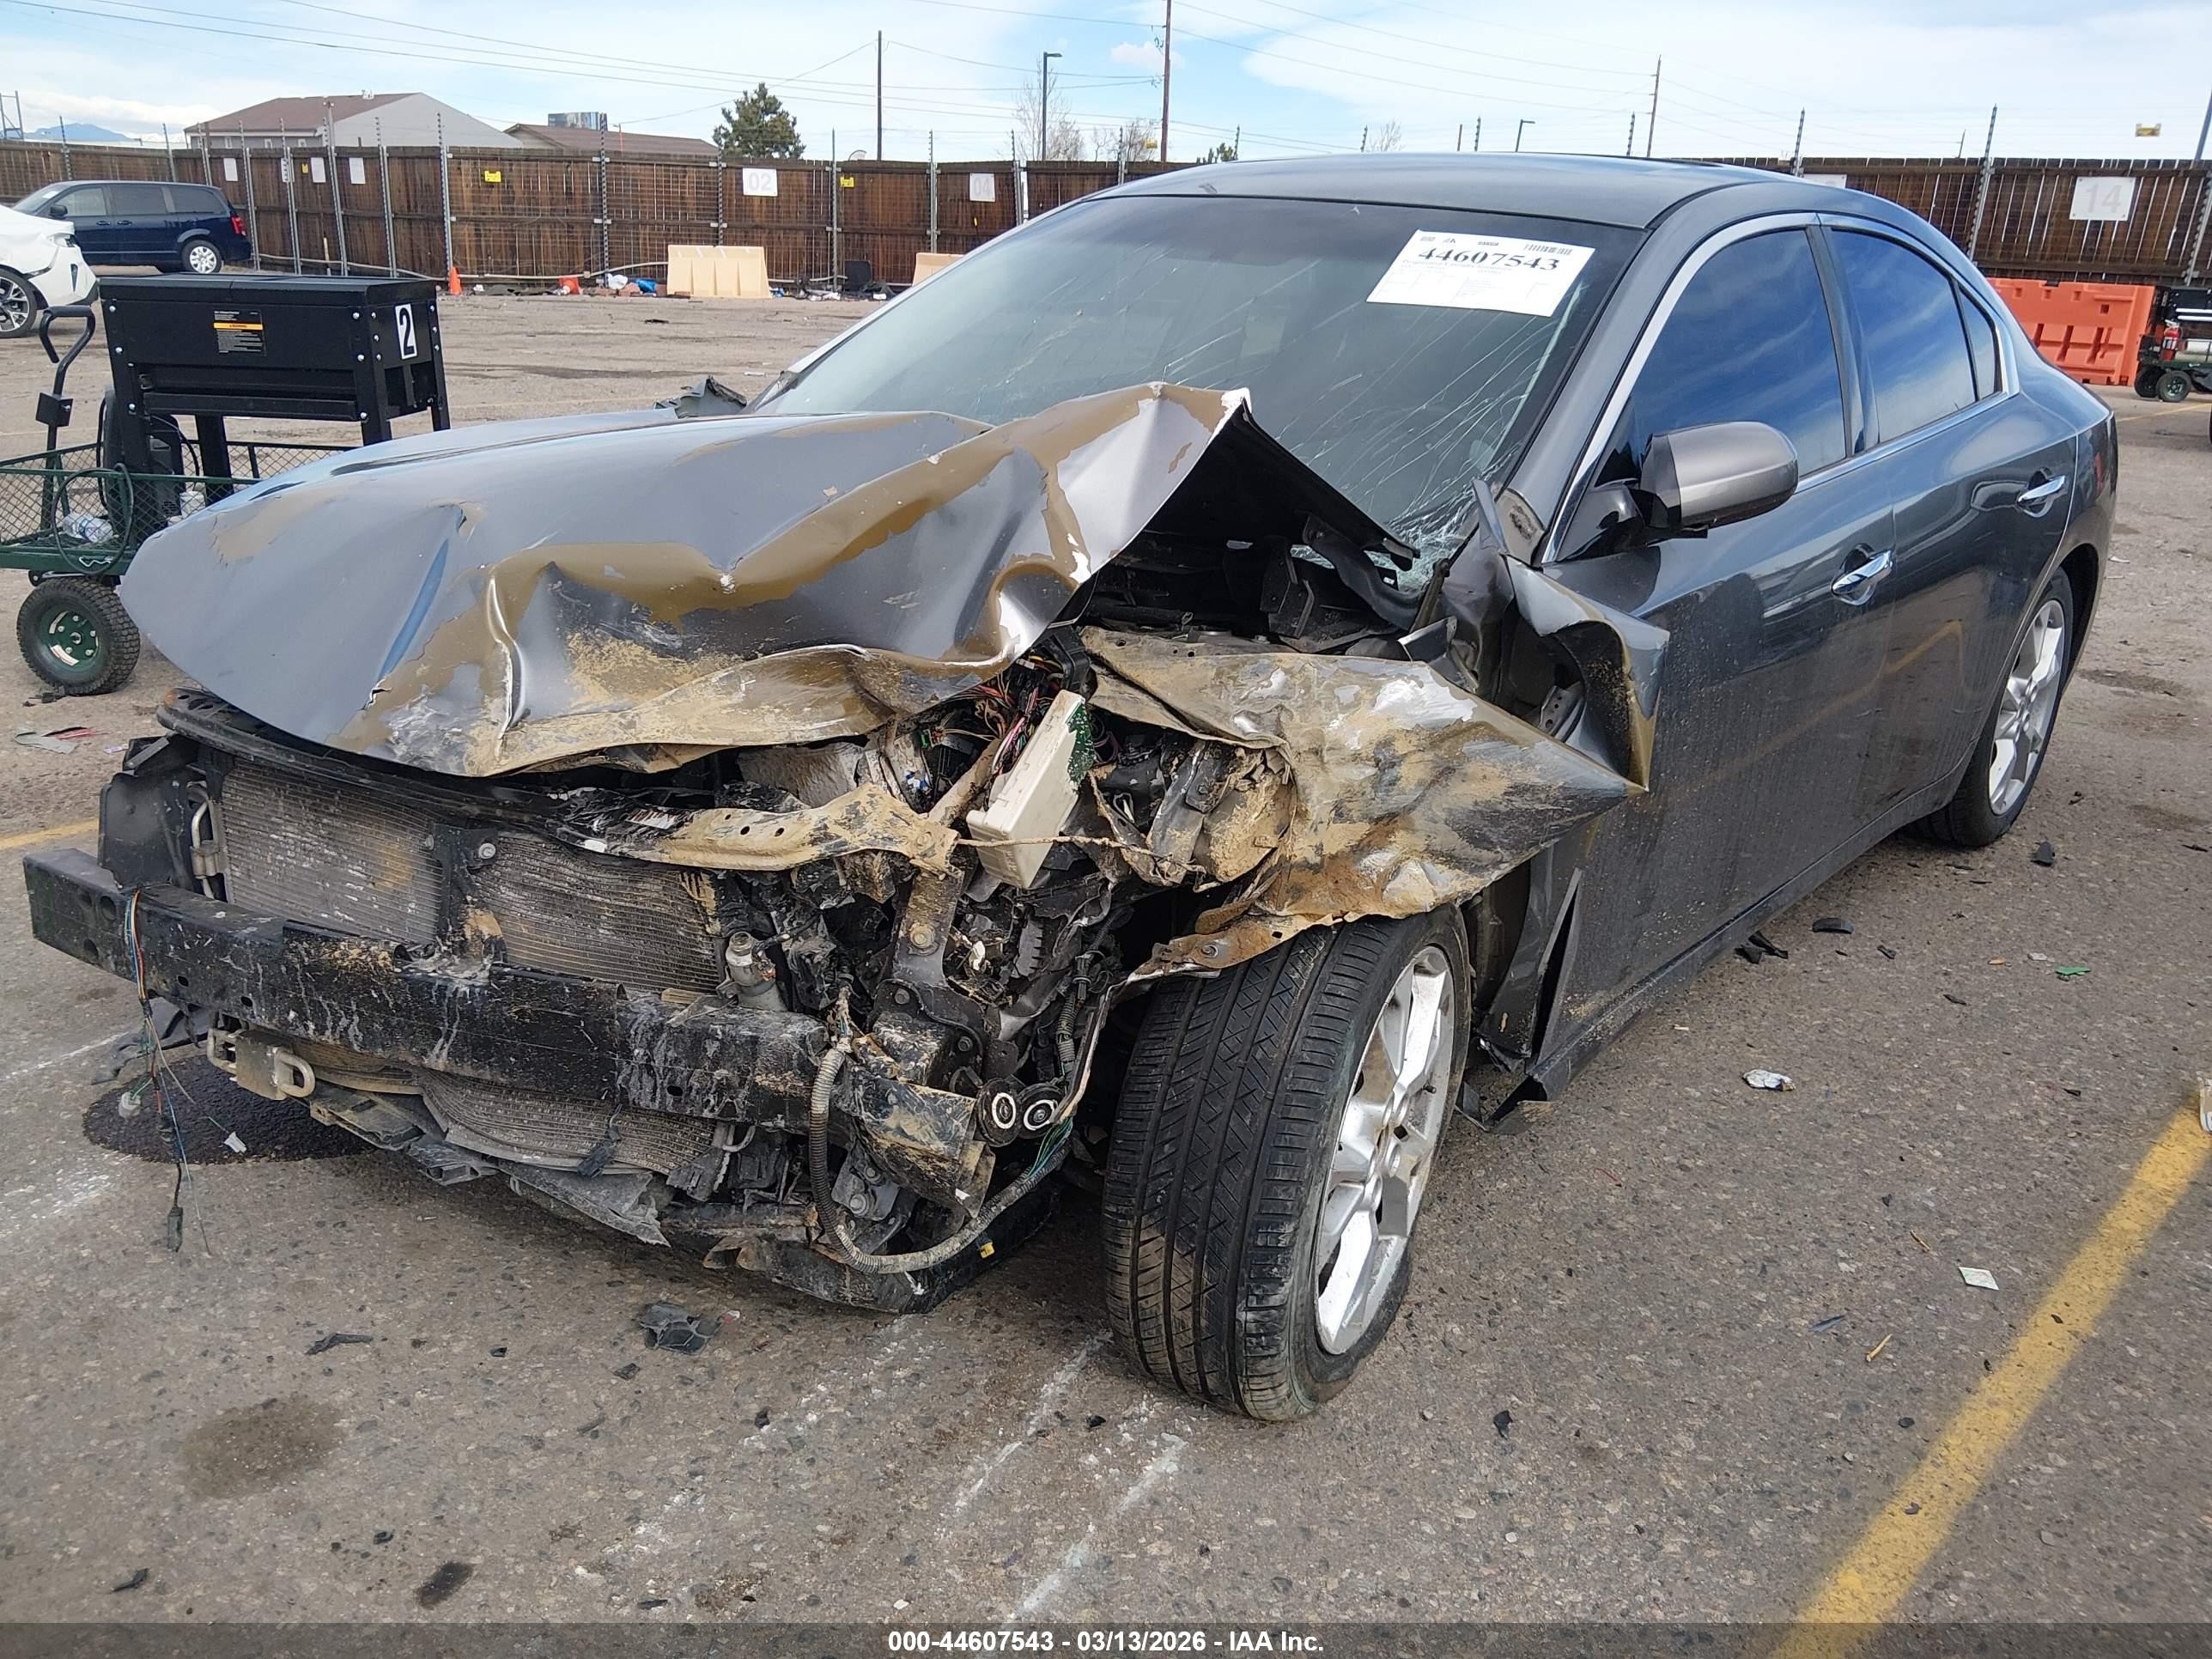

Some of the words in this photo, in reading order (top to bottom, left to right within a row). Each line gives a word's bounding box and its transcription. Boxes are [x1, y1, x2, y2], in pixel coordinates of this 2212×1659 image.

[749, 172, 771, 191] 02
[974, 177, 991, 197] 04
[2086, 183, 2123, 214] 14
[1419, 247, 1559, 270] 44607543
[398, 307, 416, 356] 2
